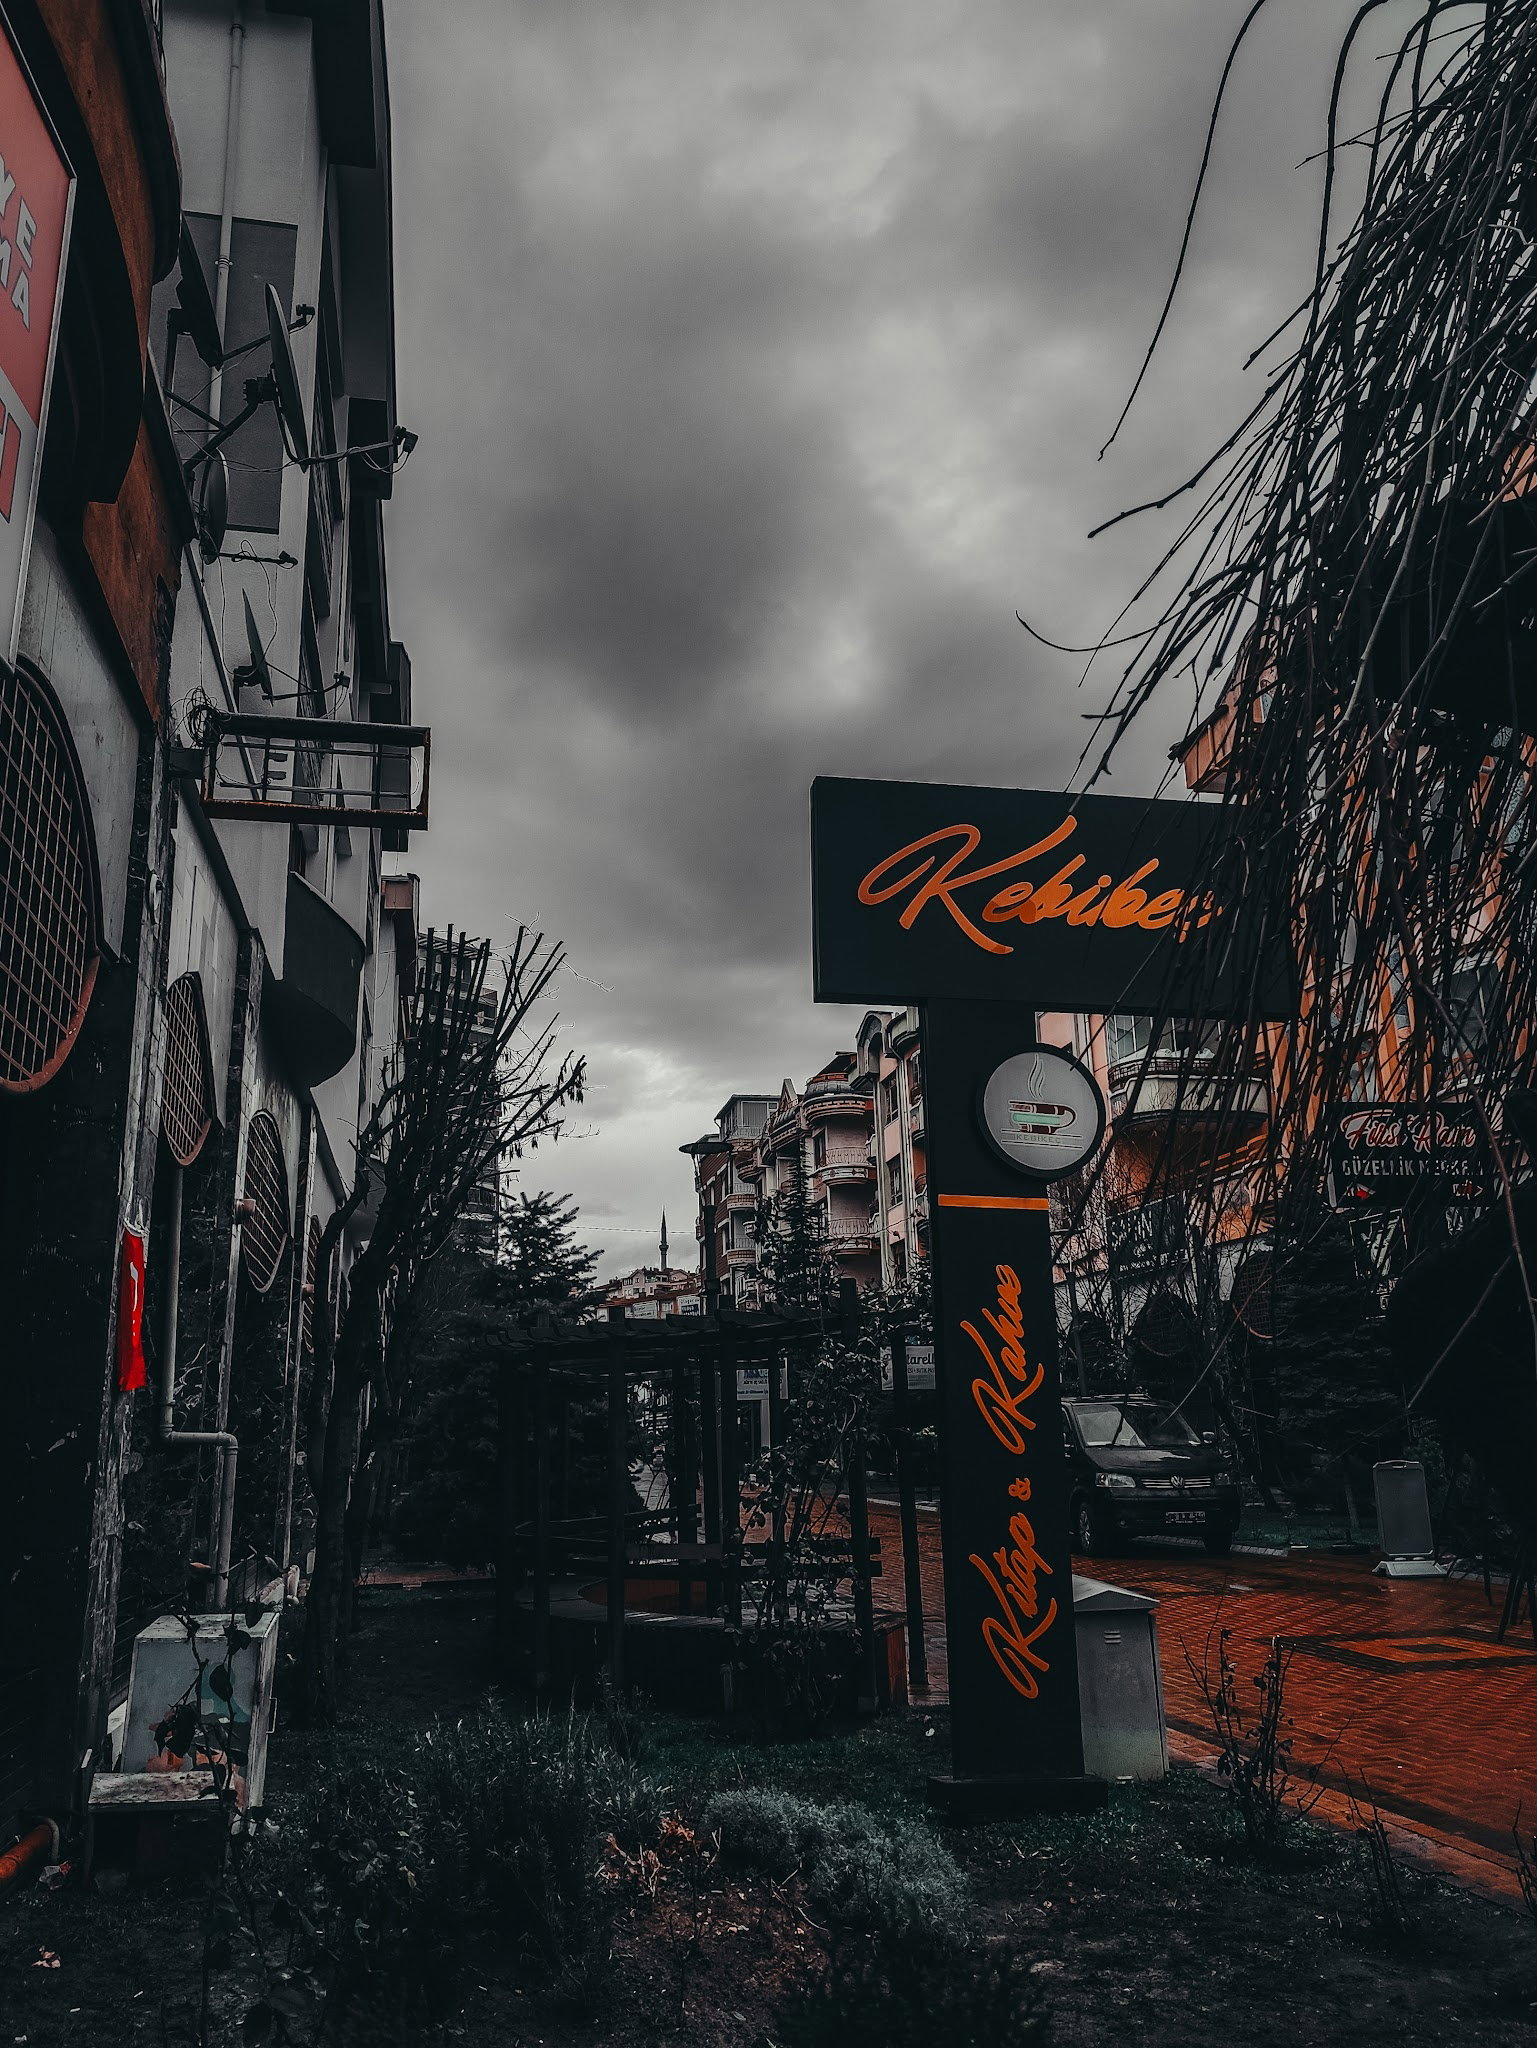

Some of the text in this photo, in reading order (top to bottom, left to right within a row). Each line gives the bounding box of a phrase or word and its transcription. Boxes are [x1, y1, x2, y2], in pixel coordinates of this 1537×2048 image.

[959, 1264, 1057, 1699] Kitap & Kahve
